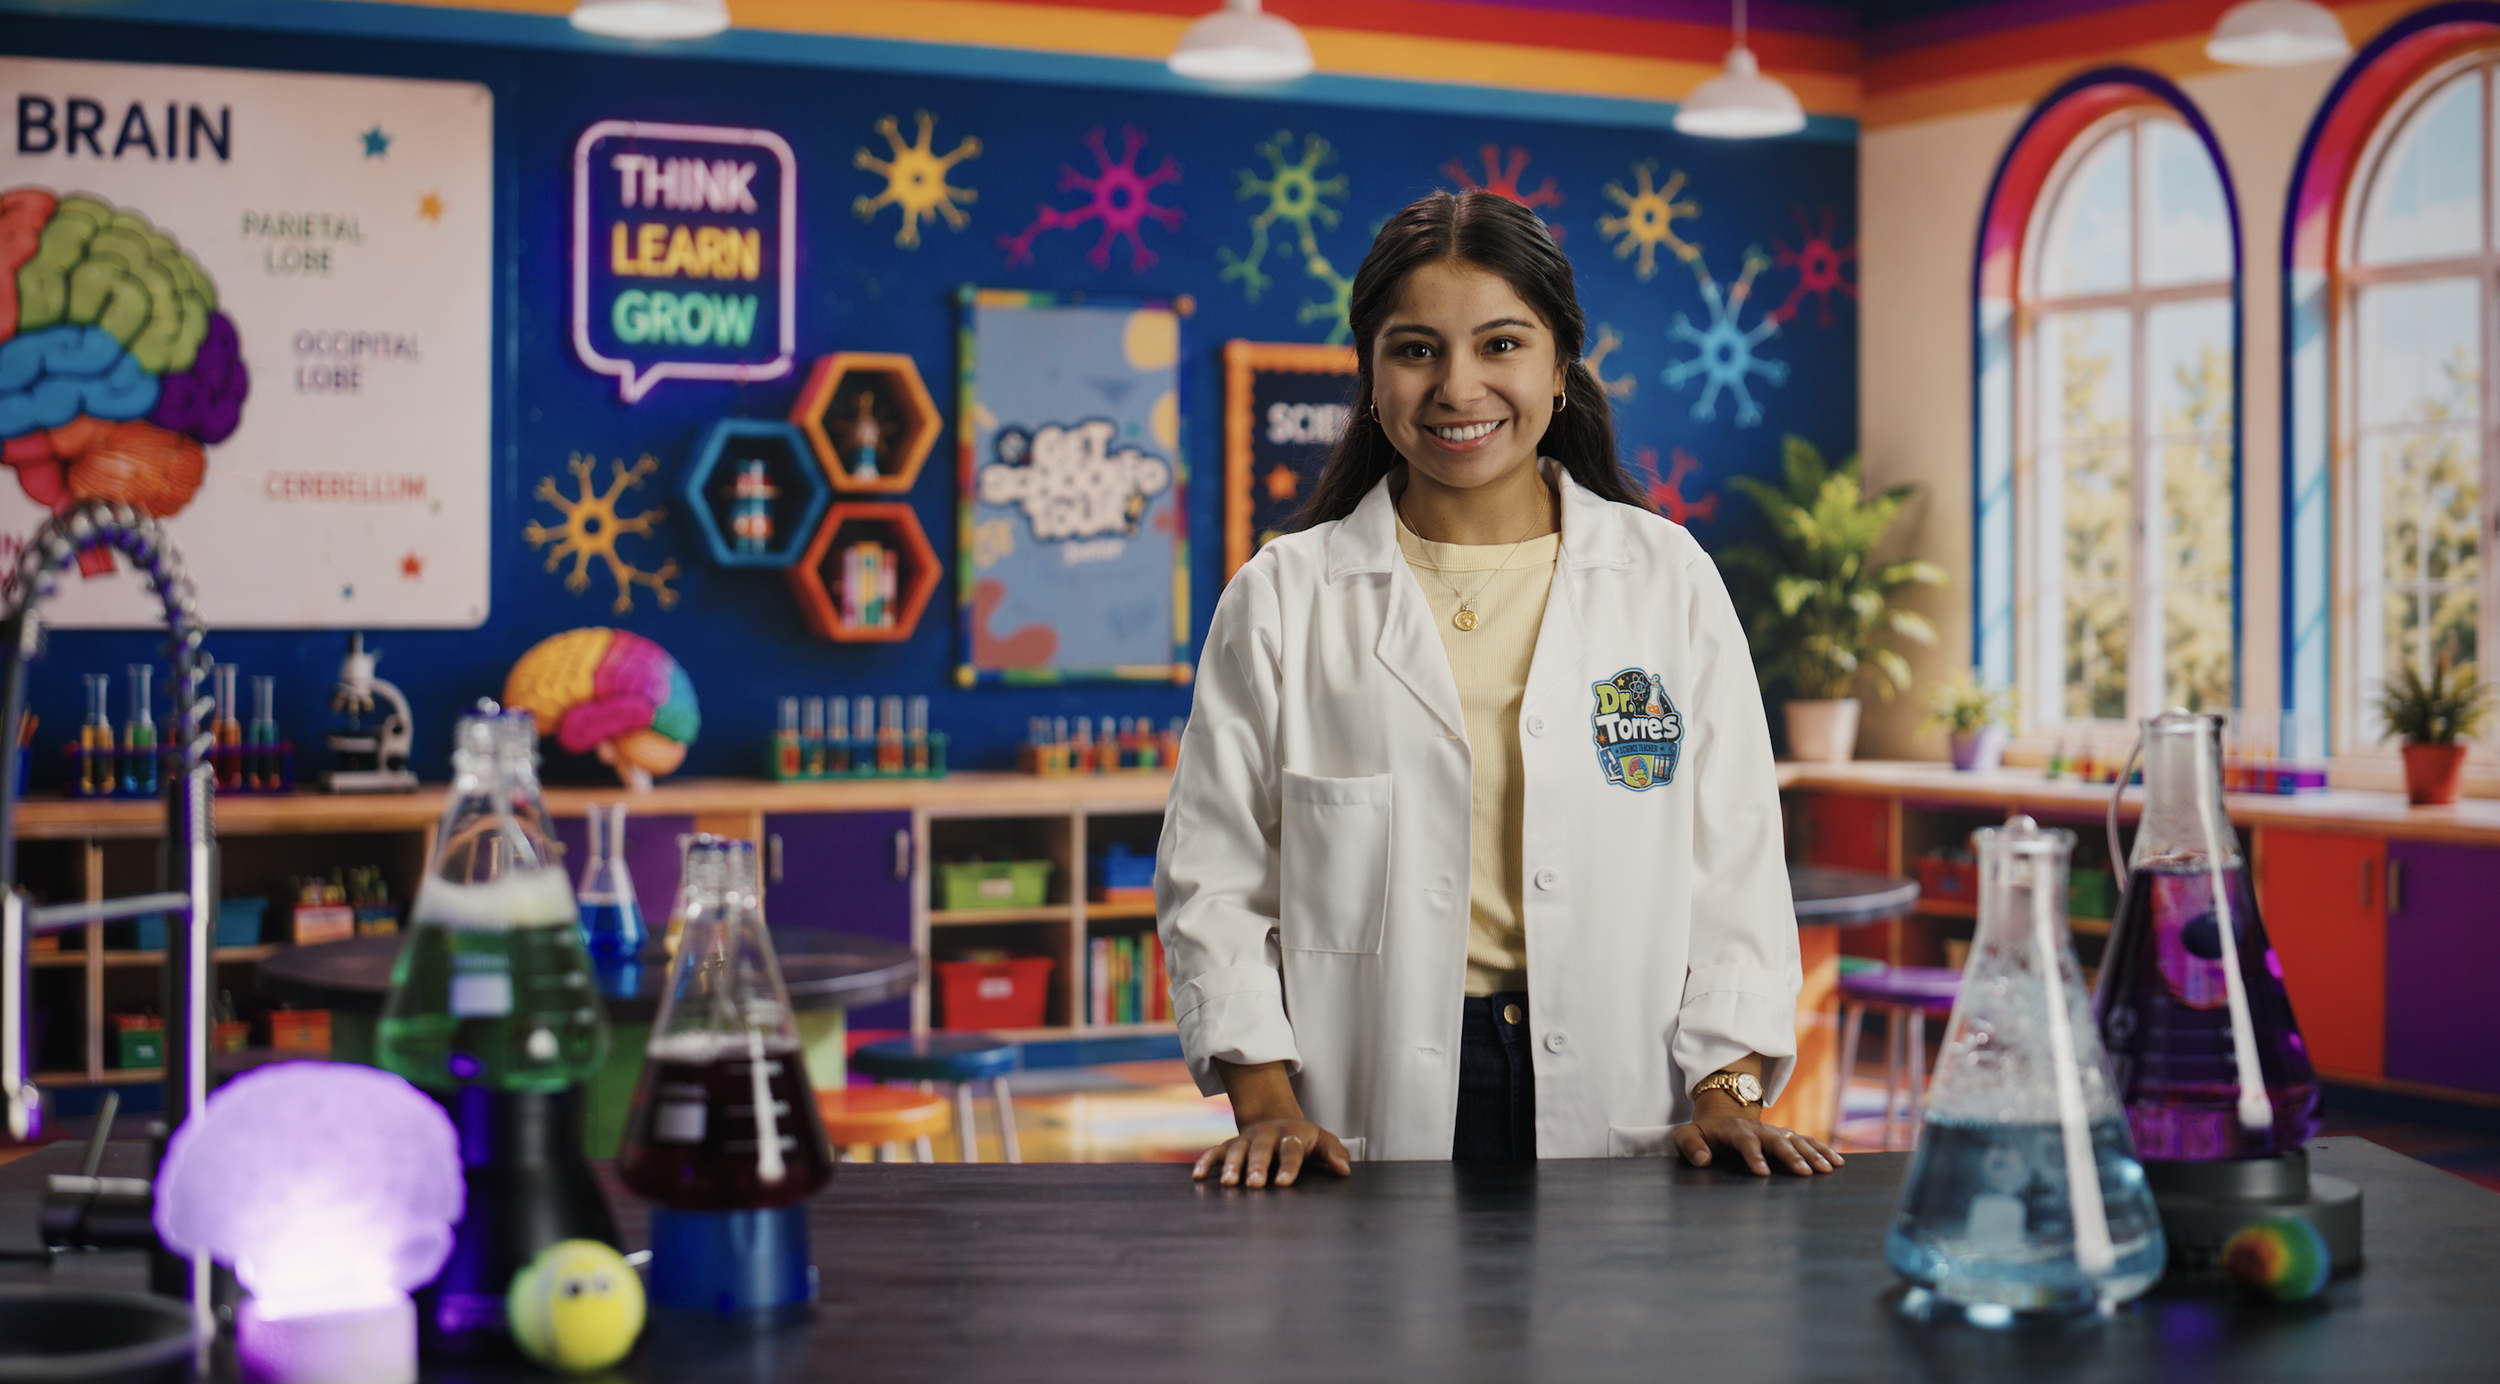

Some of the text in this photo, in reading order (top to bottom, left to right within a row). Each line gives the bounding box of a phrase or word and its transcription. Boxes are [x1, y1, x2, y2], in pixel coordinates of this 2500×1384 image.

[17, 92, 232, 163] BRAIN
[611, 154, 758, 214] THINK
[243, 210, 366, 245] PARIETAL
[265, 245, 333, 276] LOBE
[611, 220, 761, 282] LEARN
[611, 289, 759, 348] GROW
[294, 329, 422, 365] OCCIPITAL
[296, 364, 362, 394] LOBE
[1266, 402, 1351, 444] SCIE
[263, 470, 428, 504] CEREBELLUM
[1596, 684, 1634, 714] Dr.
[1595, 712, 1680, 744] Torres
[1619, 743, 1659, 755] SCIENCE TEACHER
